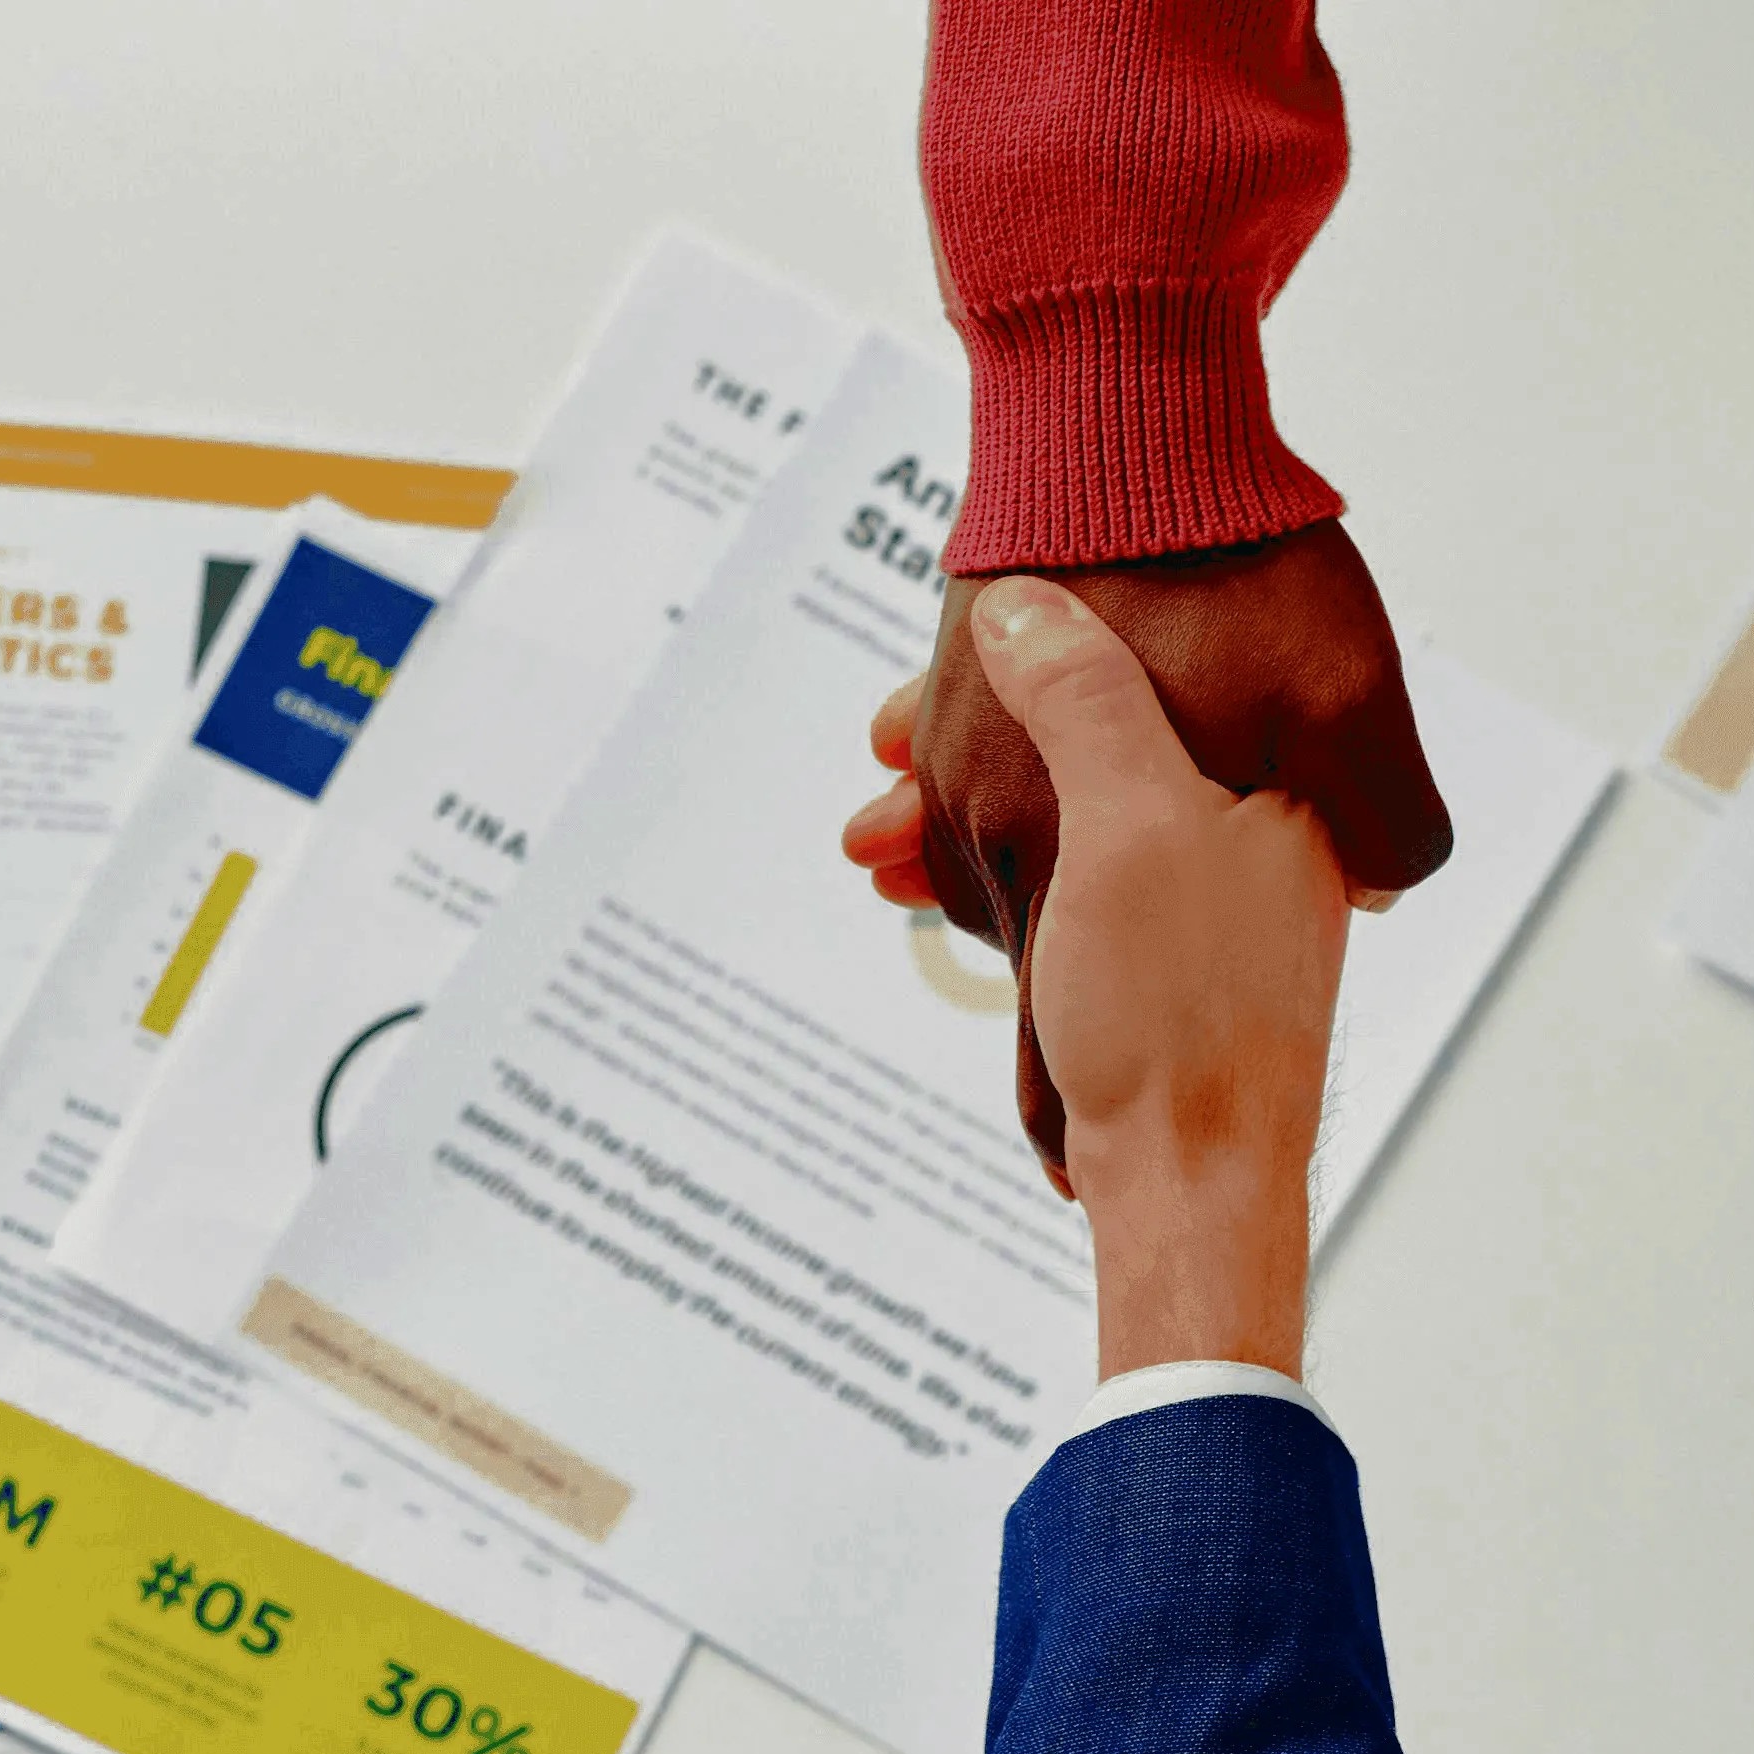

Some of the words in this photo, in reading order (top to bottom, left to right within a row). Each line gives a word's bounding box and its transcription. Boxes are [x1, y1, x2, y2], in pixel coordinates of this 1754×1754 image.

[694, 360, 768, 419] THE
[99, 595, 131, 638] &
[433, 791, 528, 864] FINA
[137, 1552, 296, 1658] #05
